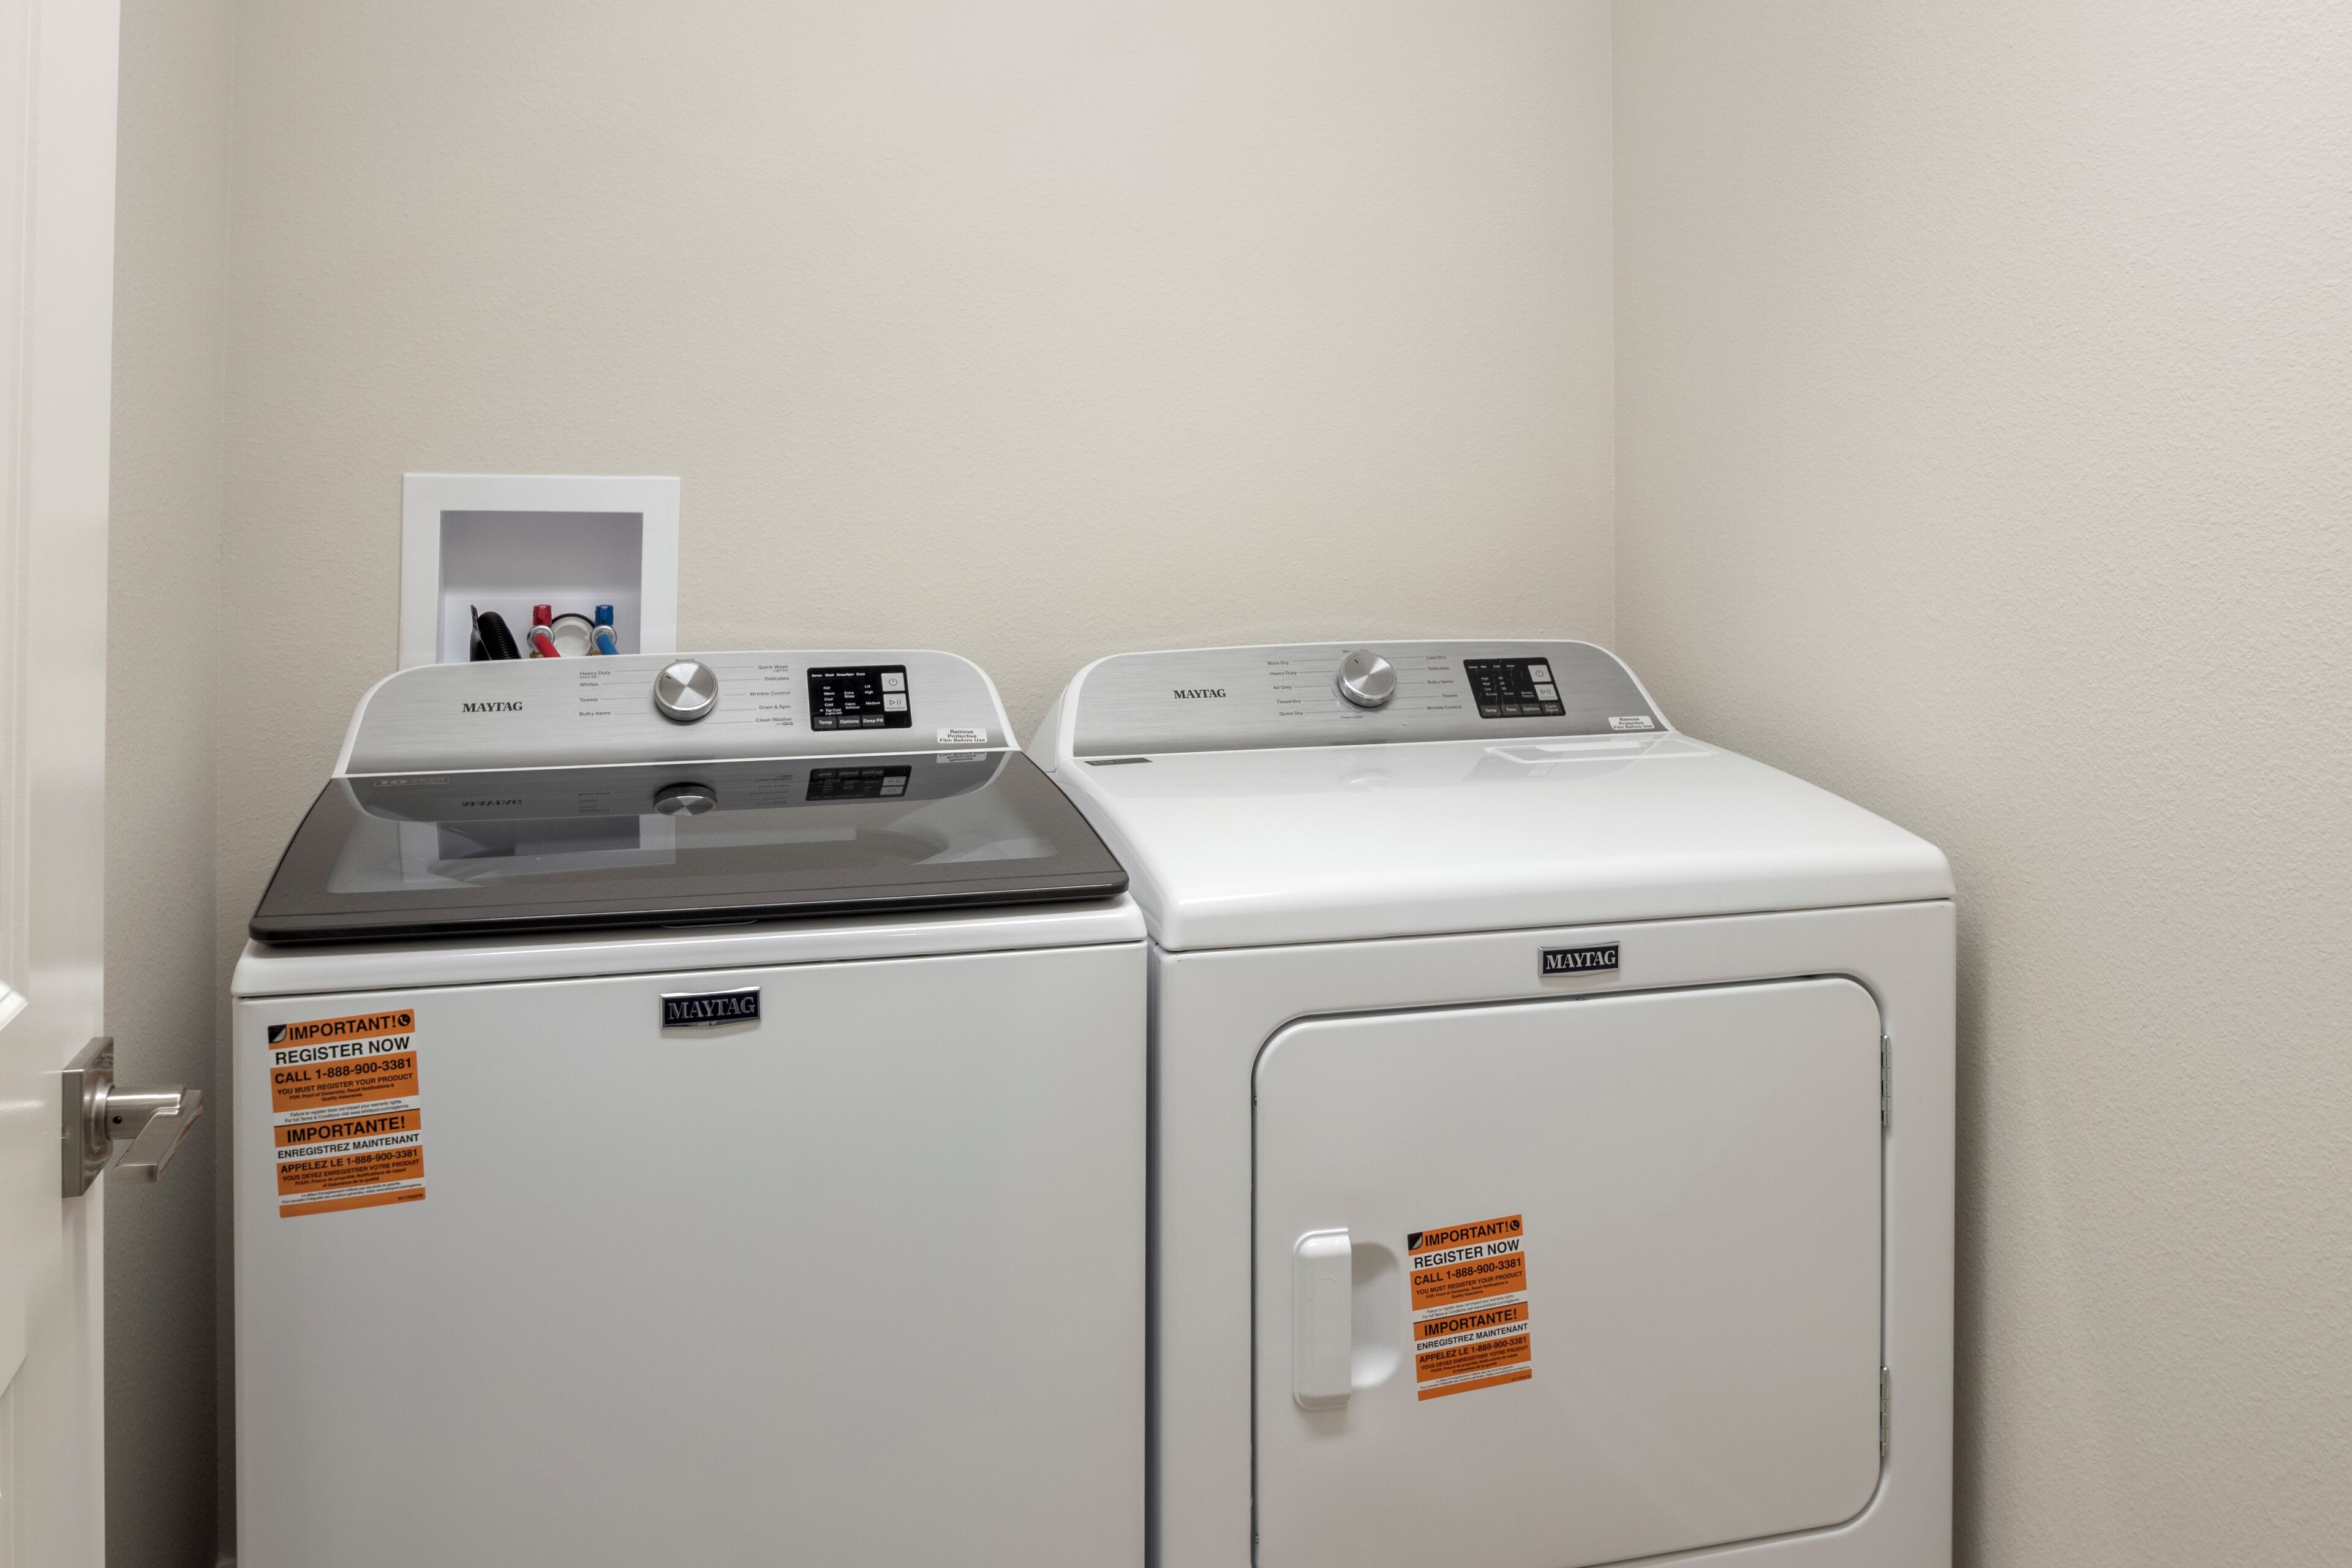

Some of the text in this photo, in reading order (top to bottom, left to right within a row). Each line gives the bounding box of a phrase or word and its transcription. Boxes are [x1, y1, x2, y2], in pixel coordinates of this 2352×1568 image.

[1174, 689, 1226, 699] MAYTAG
[462, 702, 523, 713] MAYTAG
[1546, 951, 1616, 969] MAYTAG
[668, 997, 755, 1020] MAYTAG
[290, 1016, 395, 1039] IMPORTANT!
[276, 1036, 410, 1065] REGISTER NOW
[275, 1058, 410, 1084] CALL 1-888-900-3381
[317, 1080, 352, 1090] REGISTER
[378, 1073, 412, 1082] PRODUCT
[287, 1116, 404, 1142] IMPORTANTE!
[278, 1134, 419, 1158] ENREGISTREZ MAINTENANT
[281, 1160, 327, 1173] APPELEZ
[347, 1148, 417, 1164] 1-888-900-3381
[323, 1166, 368, 1175] ENREGISTRER
[1425, 1221, 1507, 1246] IMPORTANT!
[1415, 1239, 1519, 1268] REGISTER NOW
[1414, 1257, 1520, 1285] CALL 1-888-900-3381
[1448, 1280, 1475, 1289] REGISTER
[1496, 1271, 1521, 1280] PRODUCT
[1425, 1308, 1516, 1336] IMPORTANTE!
[1417, 1322, 1527, 1351] ENREGISTREZ MAINTENANT
[1420, 1349, 1455, 1363] APPELEZ
[1472, 1335, 1526, 1352] 1-888-900-3381
[1453, 1352, 1488, 1363] ENREGISTRER
